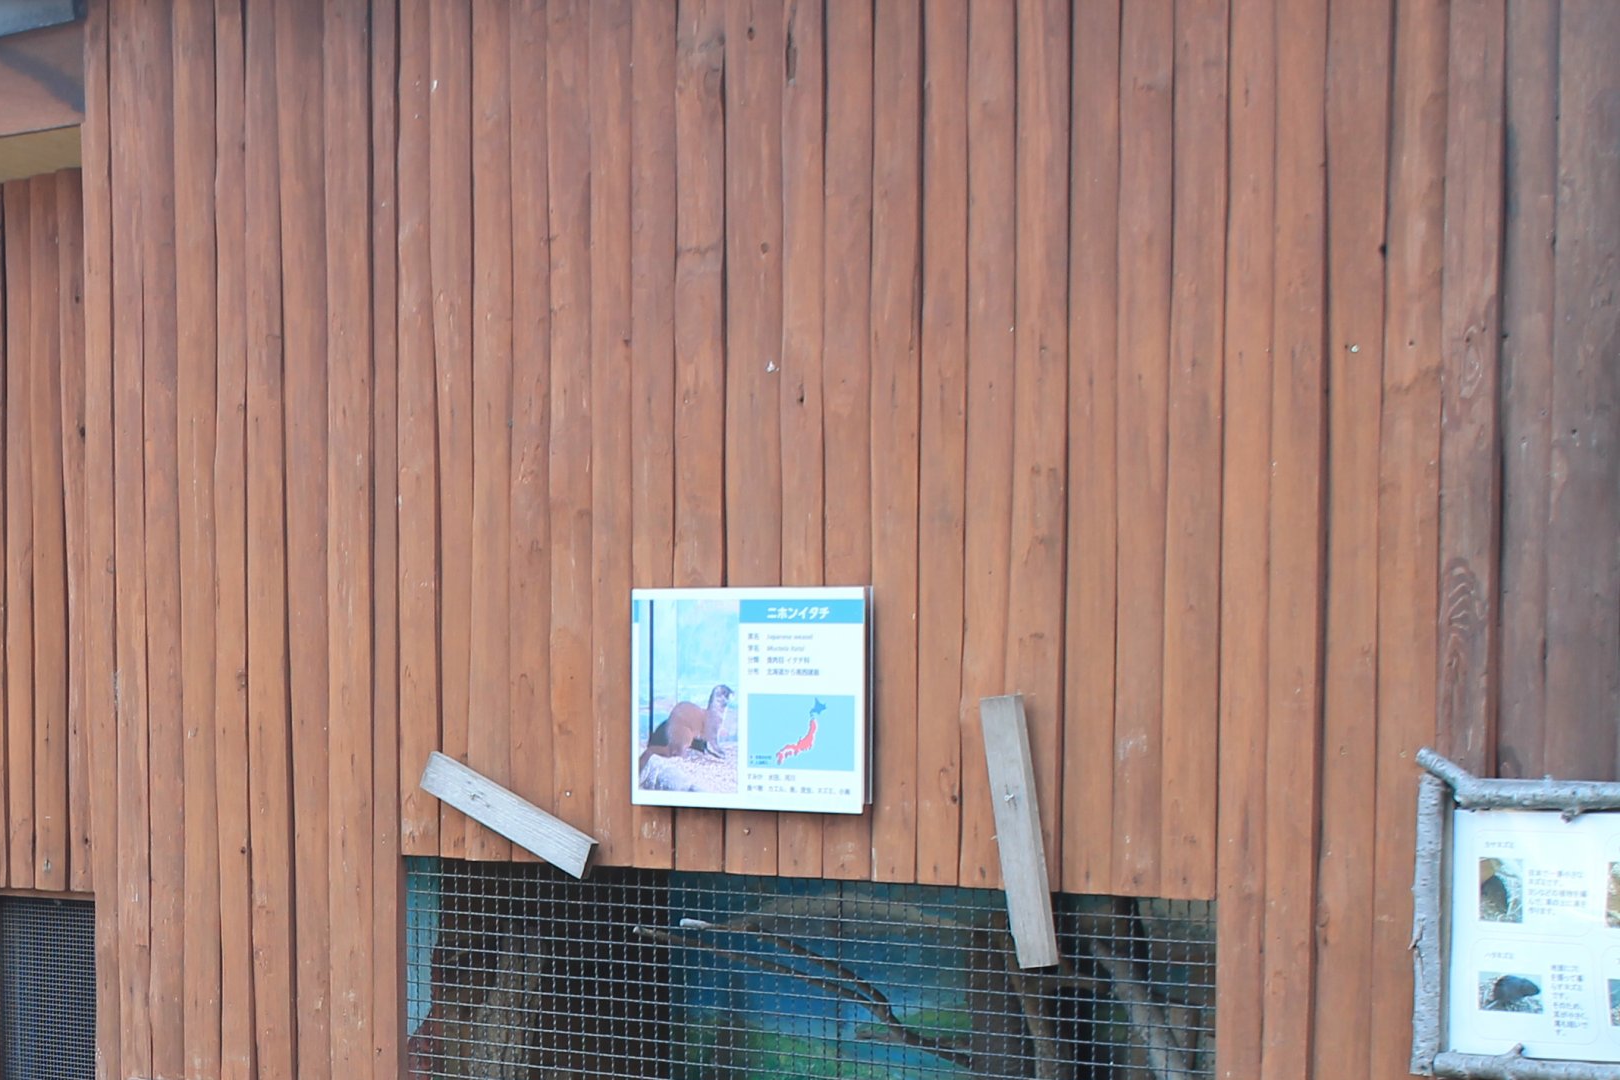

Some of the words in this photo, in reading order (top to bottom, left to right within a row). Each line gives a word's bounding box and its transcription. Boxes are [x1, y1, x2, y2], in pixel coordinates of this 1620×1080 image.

[766, 606, 830, 620] ニホンイタチ
